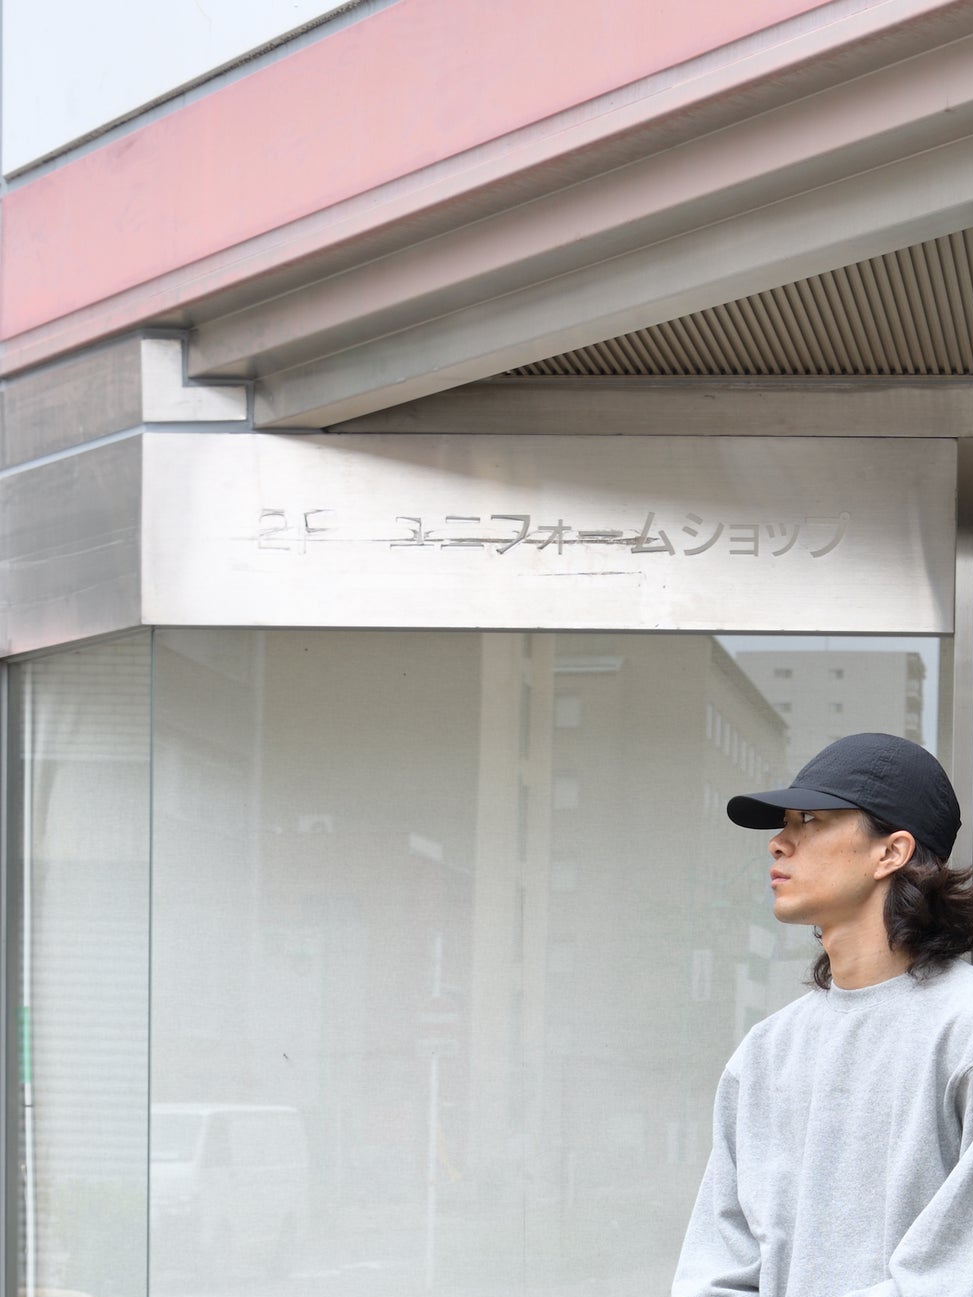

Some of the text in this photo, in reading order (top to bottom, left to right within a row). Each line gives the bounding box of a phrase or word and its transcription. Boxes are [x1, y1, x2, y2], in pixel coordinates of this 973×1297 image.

[389, 511, 851, 558] ユニフォームショップ
